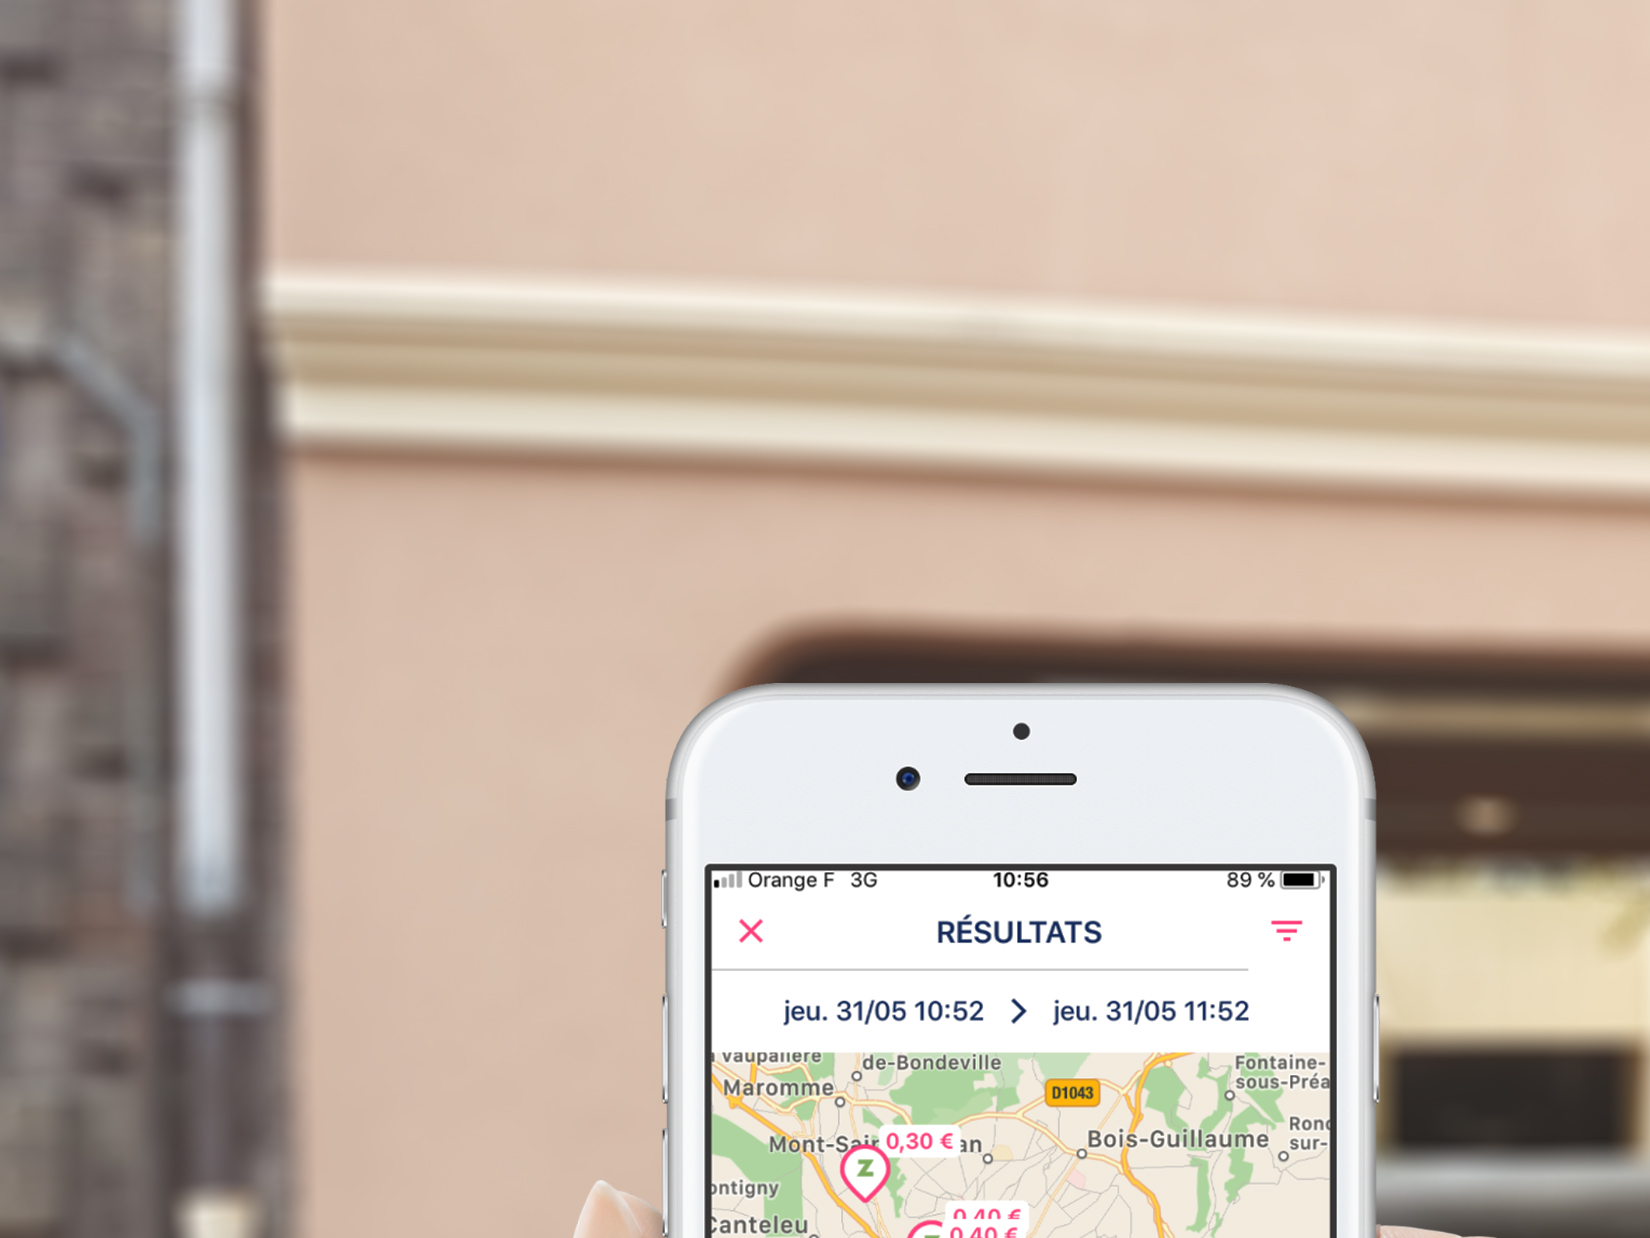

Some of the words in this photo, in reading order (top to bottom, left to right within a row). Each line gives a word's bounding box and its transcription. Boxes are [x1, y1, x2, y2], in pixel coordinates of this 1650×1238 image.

[749, 873, 817, 891] Orange
[824, 873, 834, 887] F
[851, 873, 877, 888] 3G
[994, 873, 1048, 888] 10:56
[1227, 873, 1252, 888] 89
[1258, 873, 1275, 887] %
[938, 914, 1102, 944] RÉSULTATS
[783, 1000, 827, 1025] jeu.
[837, 1000, 906, 1025] 31/05
[915, 1000, 983, 1021] 10:52
[1053, 1000, 1097, 1025] jeu.
[1107, 1000, 1176, 1025] 31/05
[1185, 1001, 1249, 1021] 11:52
[862, 1055, 1001, 1070] de-Bondeville
[1235, 1056, 1326, 1070] Fontaine-
[723, 1079, 834, 1096] Maromme
[1235, 1074, 1330, 1089] sous-Préa
[1052, 1087, 1094, 1099] D1043
[886, 1132, 933, 1153] 0,30
[940, 1132, 953, 1149] €
[1088, 1129, 1269, 1148] Bois-Guillaume
[1289, 1137, 1328, 1150] sur-
